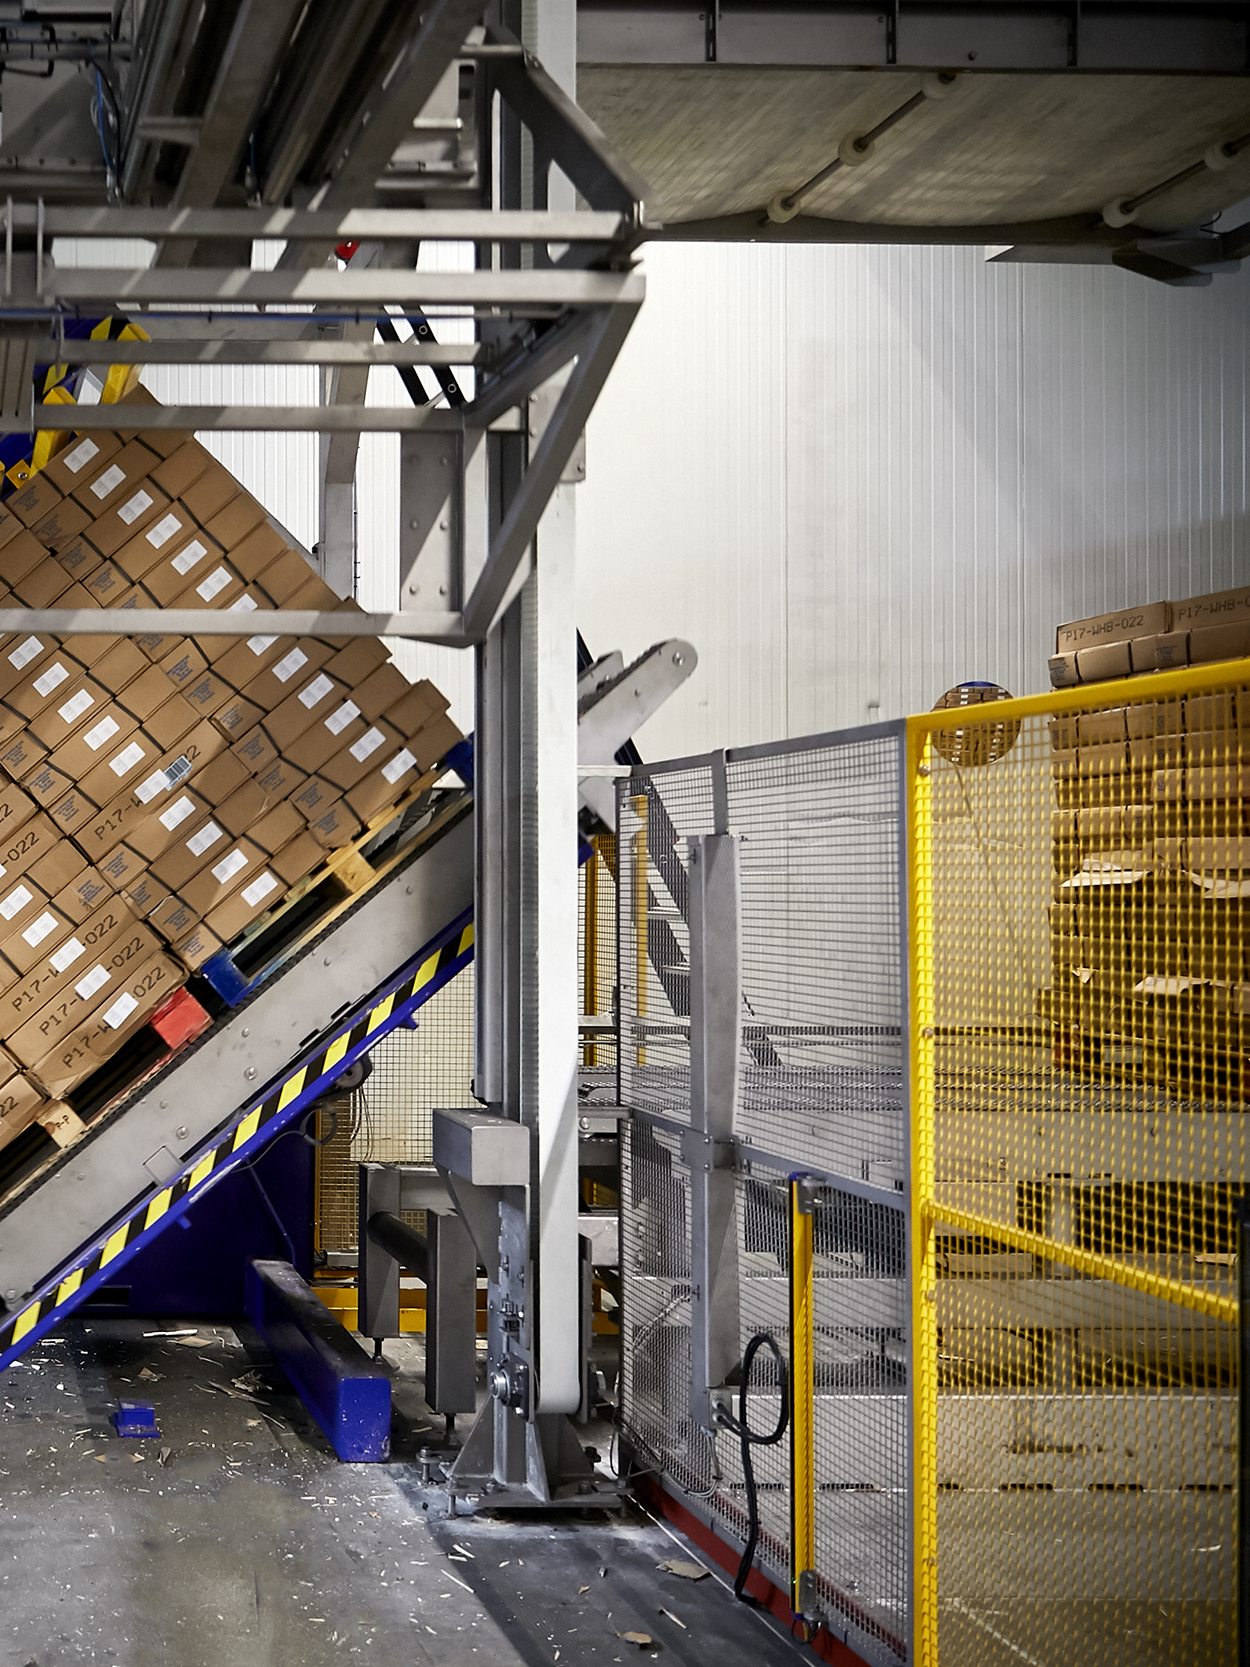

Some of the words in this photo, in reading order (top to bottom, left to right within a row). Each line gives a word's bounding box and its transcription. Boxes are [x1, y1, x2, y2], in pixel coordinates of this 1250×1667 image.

[1066, 615, 1144, 642] P17-WHB-022
[39, 937, 146, 1036] P17--022
[62, 967, 167, 1068] P17-W022
